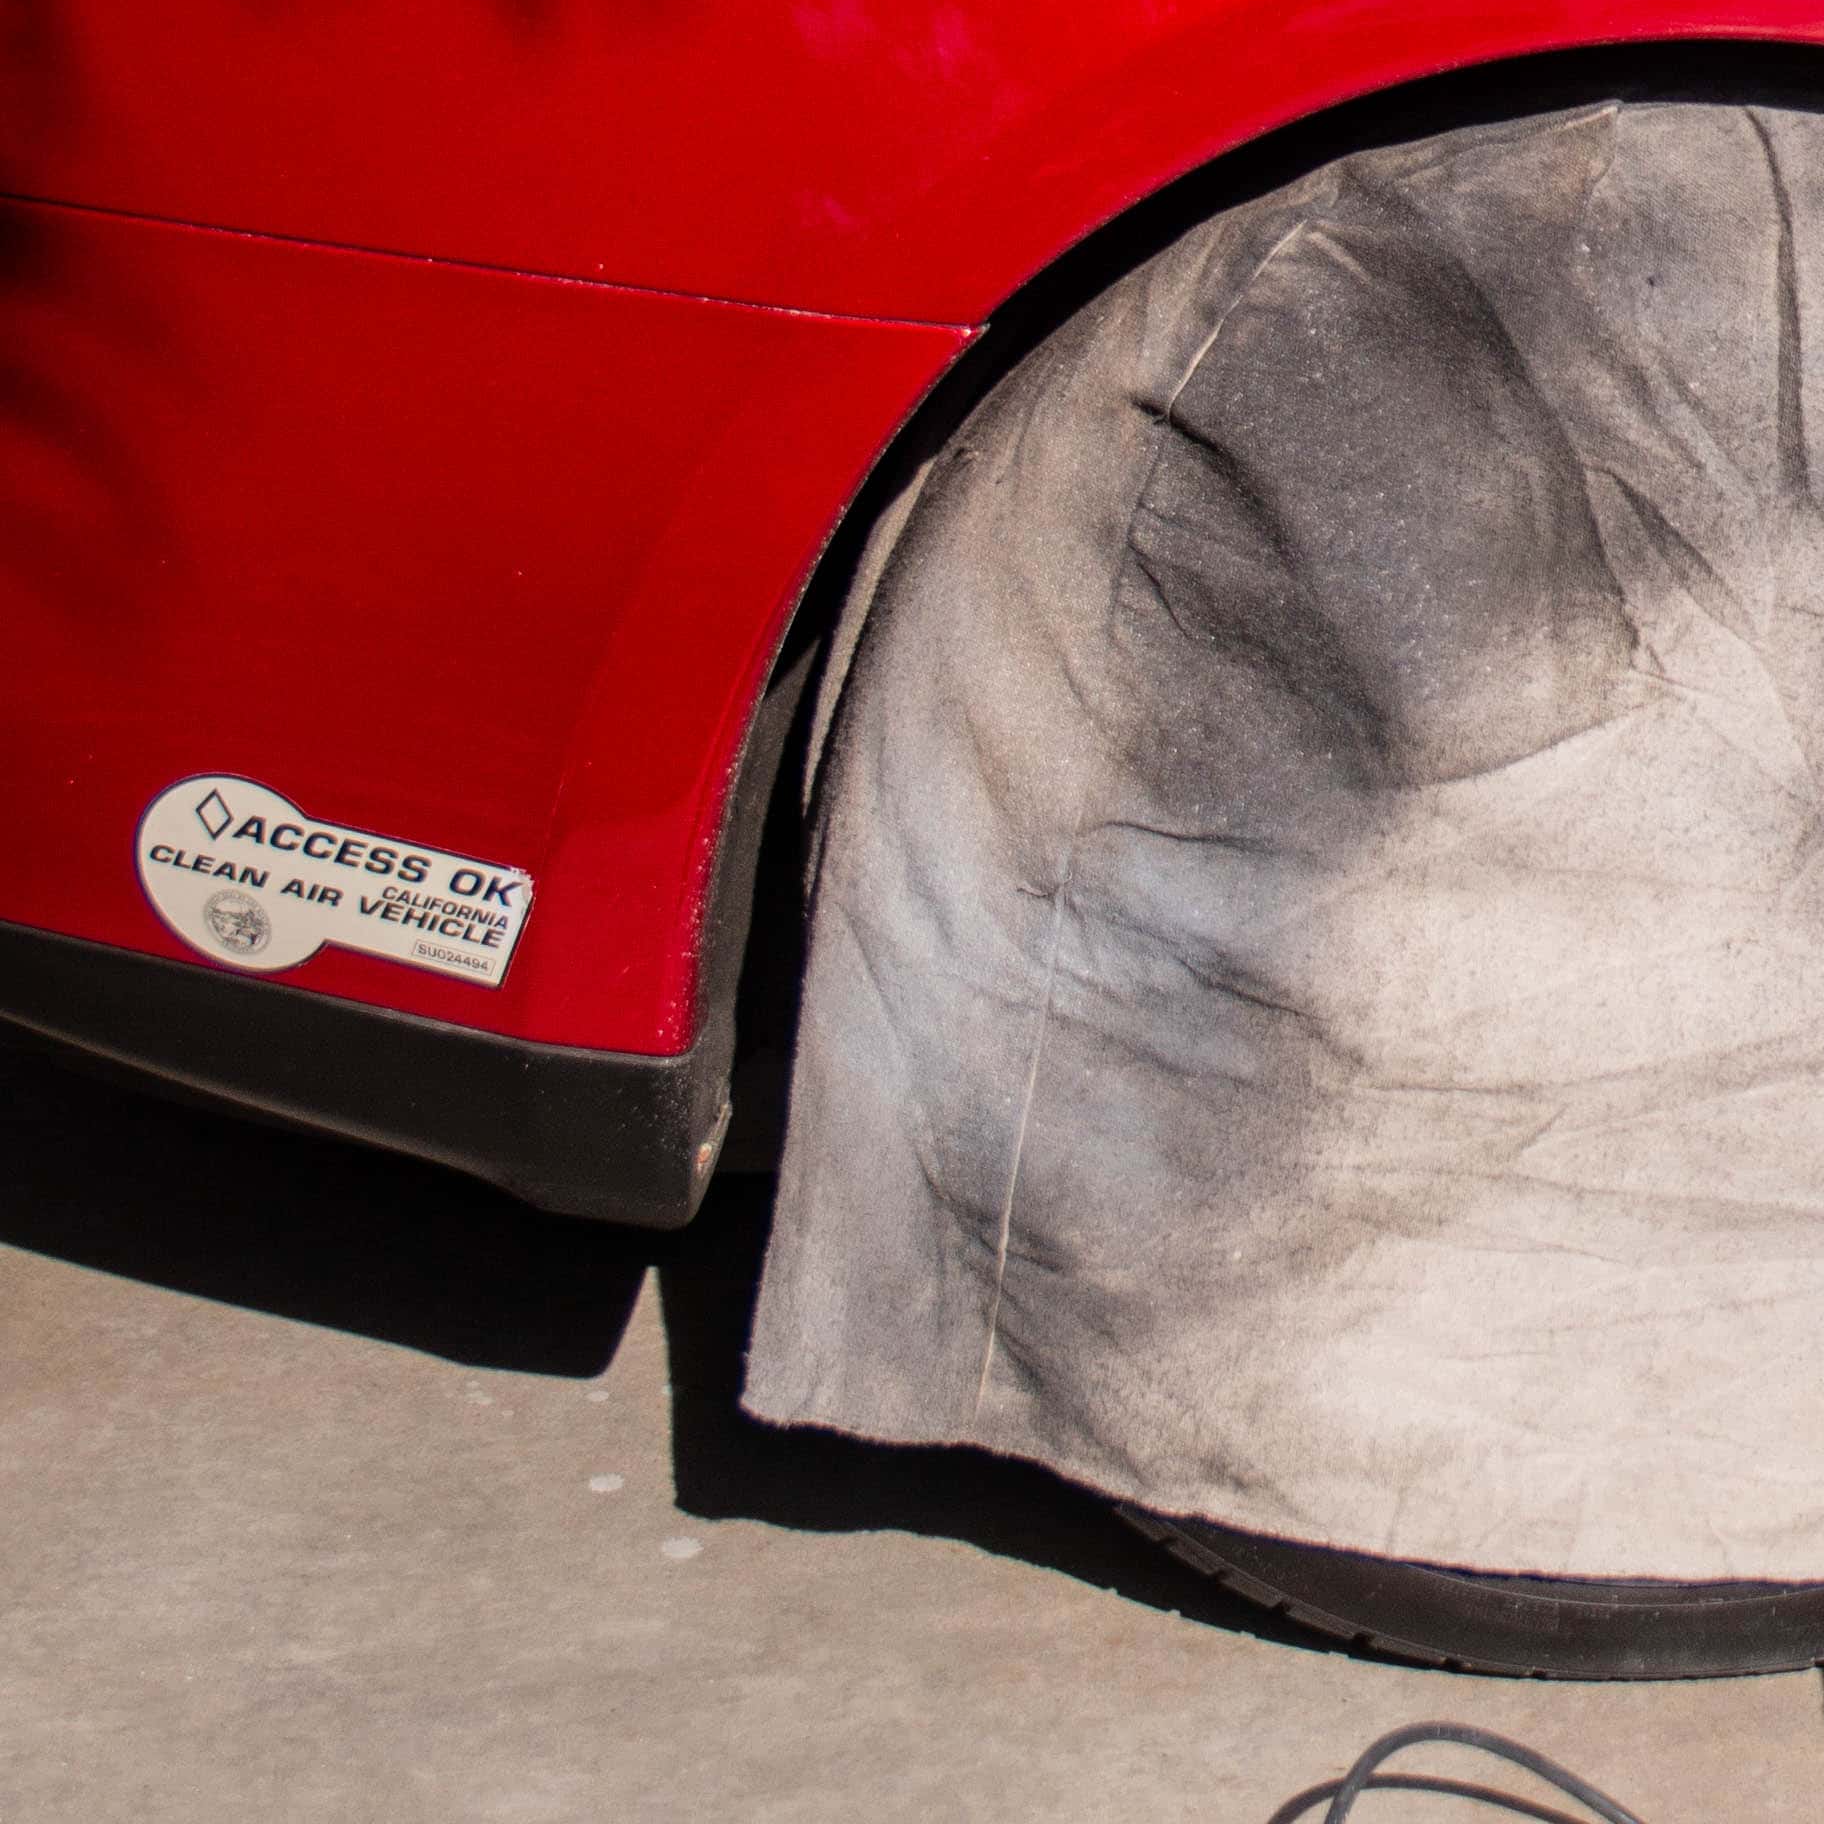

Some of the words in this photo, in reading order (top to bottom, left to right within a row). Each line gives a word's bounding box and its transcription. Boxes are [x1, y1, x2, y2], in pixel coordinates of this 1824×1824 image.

[149, 843, 272, 888] CLEAN
[280, 878, 345, 907] AIR
[359, 895, 508, 949] VEHICLE
[232, 815, 432, 884] ACCESS
[448, 866, 524, 907] OK
[381, 885, 509, 930] CALIFORNIA
